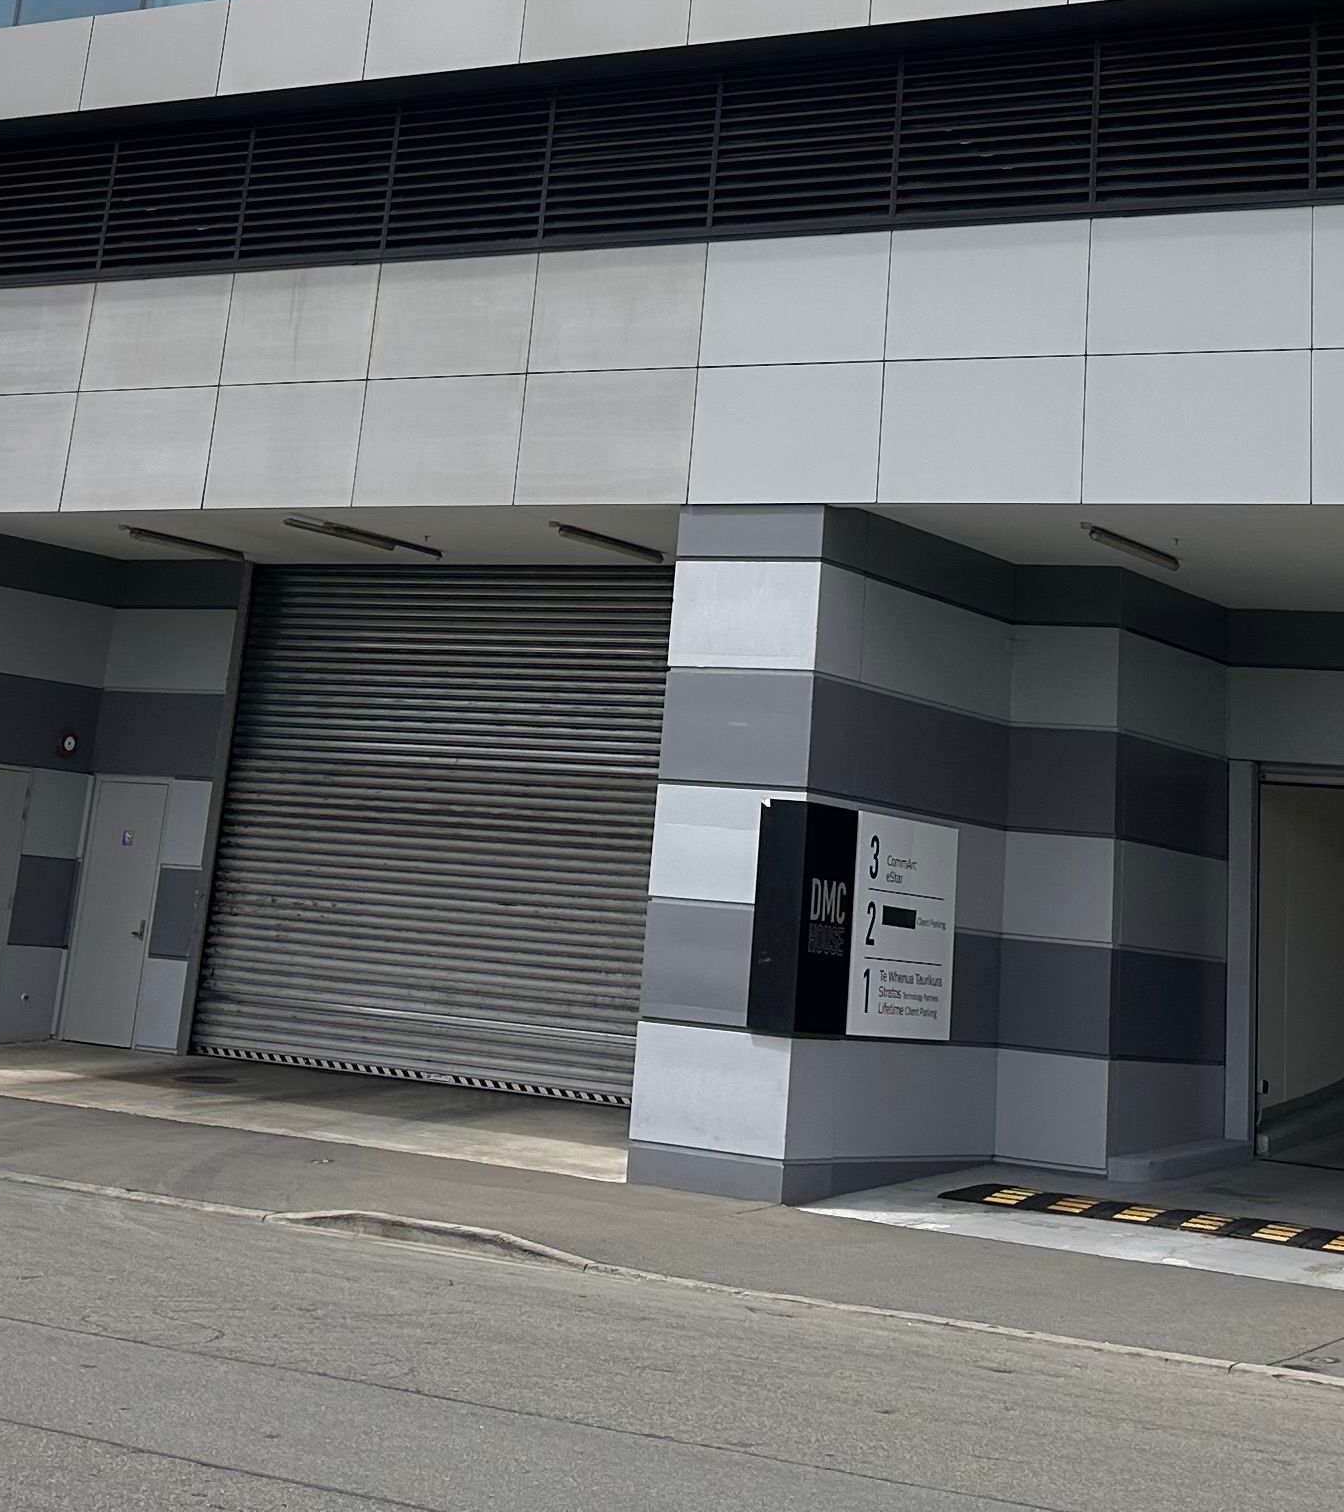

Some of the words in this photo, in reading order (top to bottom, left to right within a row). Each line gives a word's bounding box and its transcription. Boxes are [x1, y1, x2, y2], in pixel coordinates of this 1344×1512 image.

[869, 835, 880, 879] 3
[809, 877, 847, 924] DMC
[865, 900, 877, 946] 2
[863, 968, 871, 1014] 1
[879, 969, 888, 982] Te
